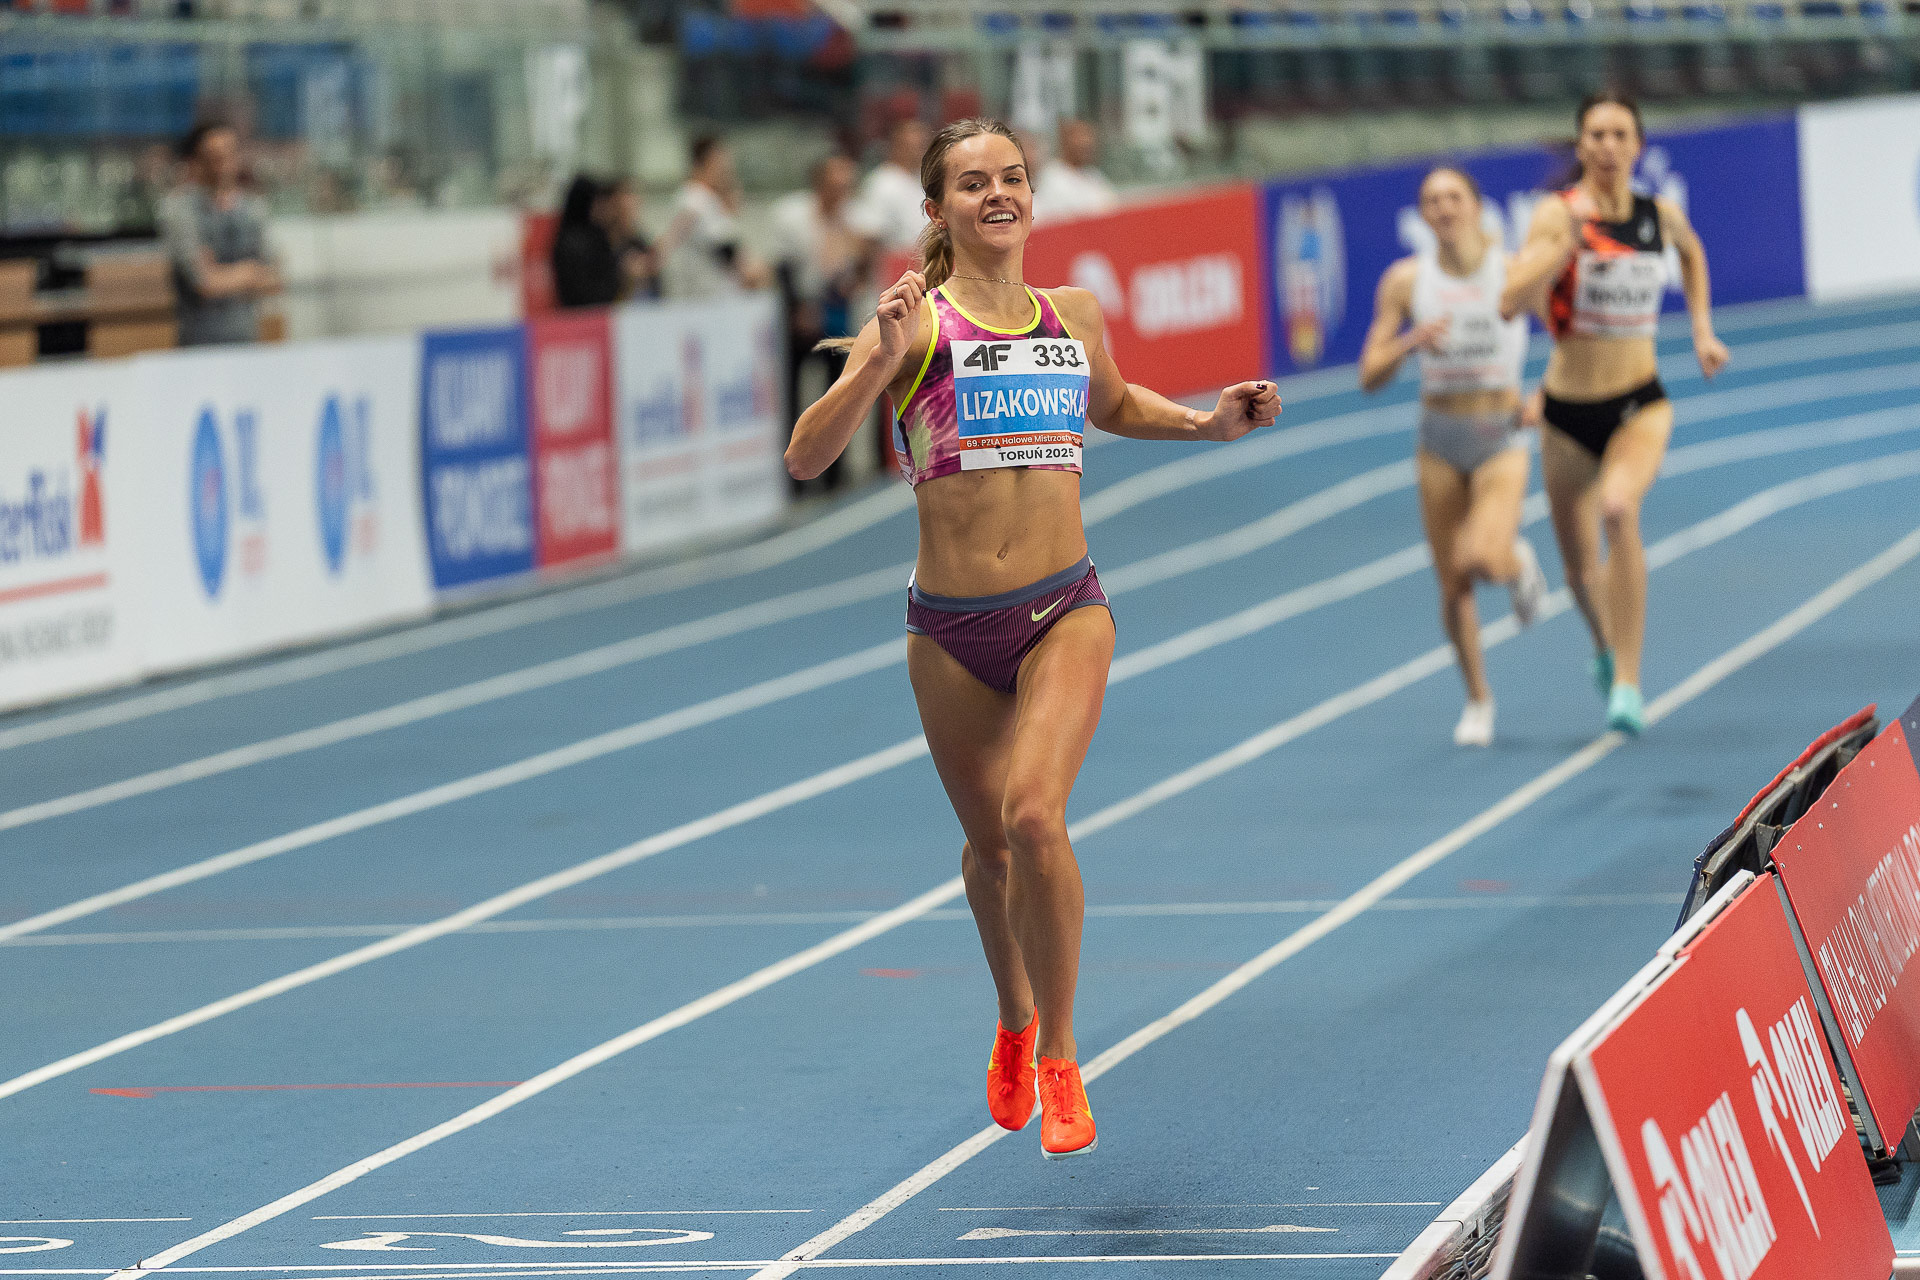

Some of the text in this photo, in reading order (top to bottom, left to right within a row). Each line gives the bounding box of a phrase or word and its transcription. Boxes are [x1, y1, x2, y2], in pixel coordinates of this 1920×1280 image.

[964, 344, 1012, 371] 4F
[1033, 345, 1079, 367] 333
[962, 388, 1085, 421] LIZAKOWSKA
[966, 439, 980, 448] 69.
[1002, 436, 1033, 445] Halowe
[998, 447, 1074, 461] TORUŃ 2025
[1768, 995, 1846, 1173] ORLEN
[1680, 1091, 1777, 1280] ORLEN
